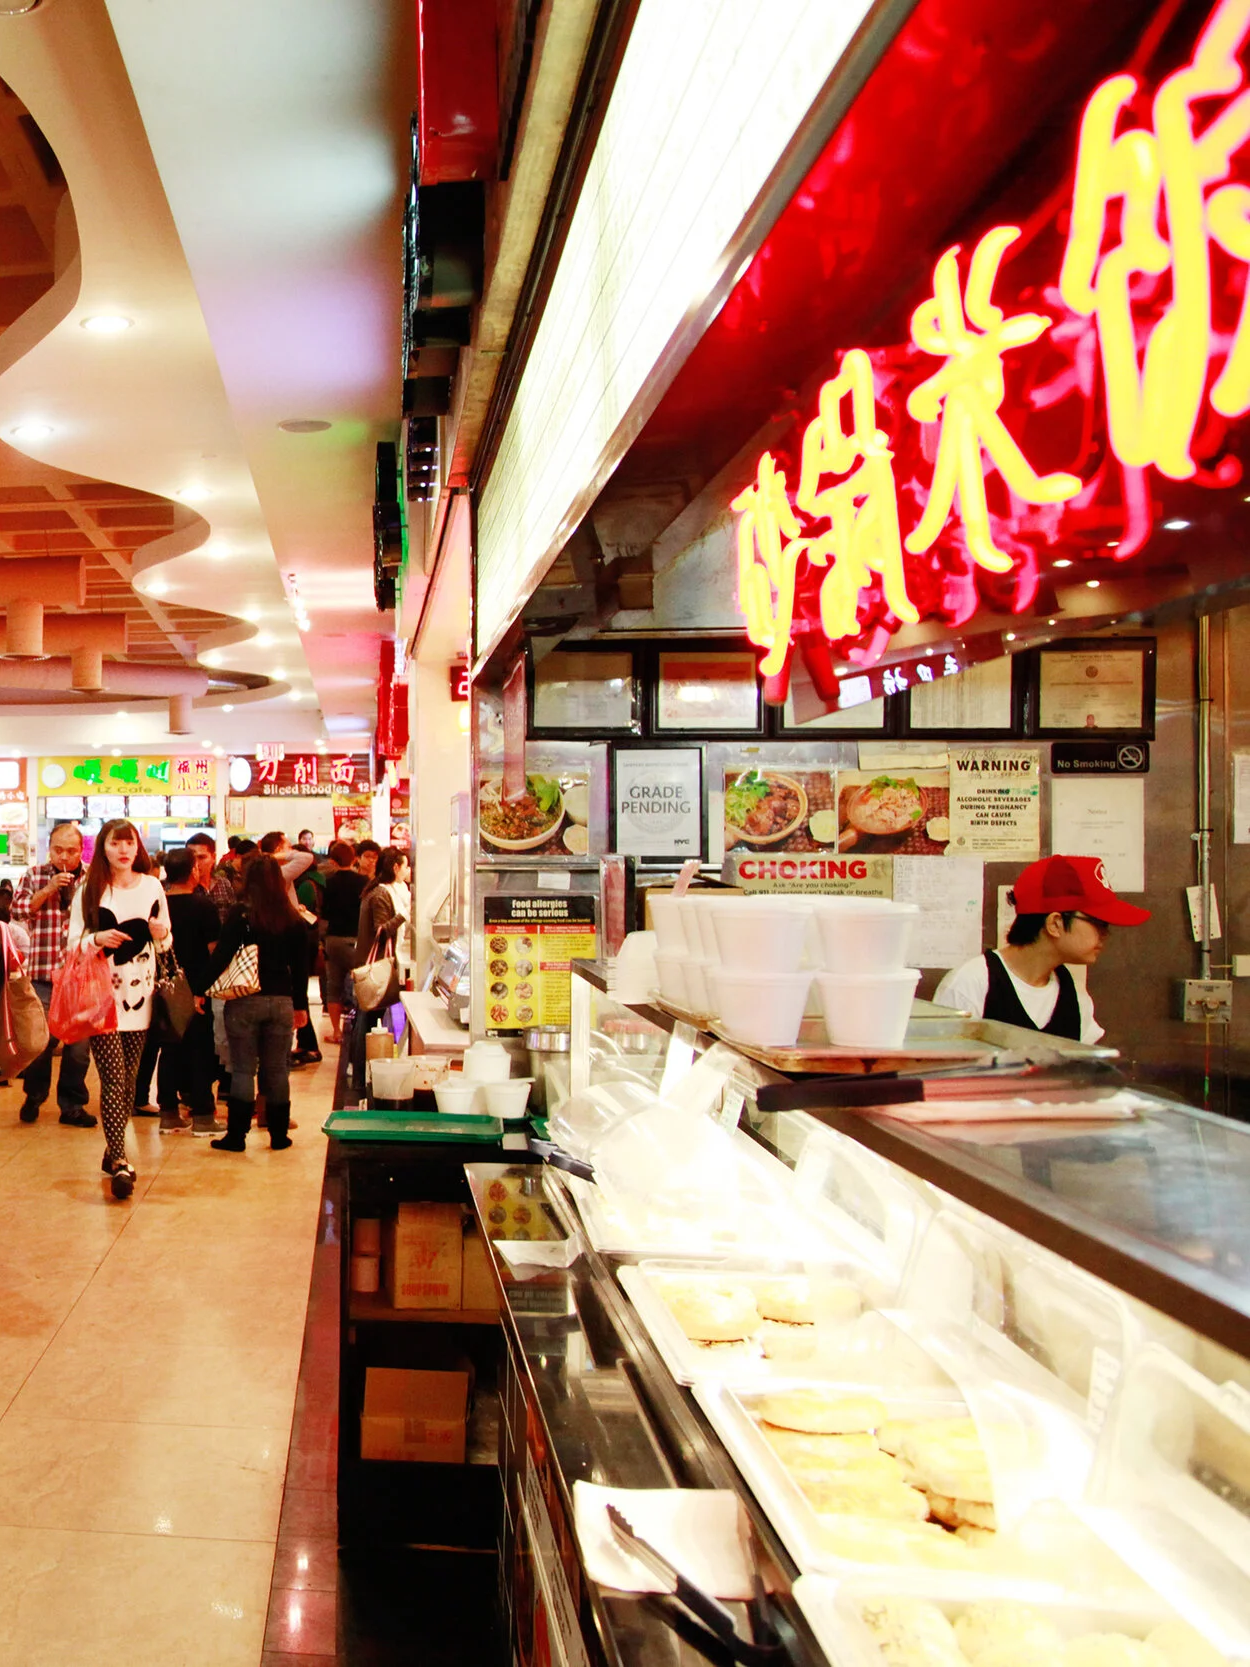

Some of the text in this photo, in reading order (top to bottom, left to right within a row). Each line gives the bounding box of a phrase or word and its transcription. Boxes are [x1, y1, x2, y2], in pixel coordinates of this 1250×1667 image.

[177, 760, 208, 774] 福州
[258, 756, 357, 784] 刀削面
[956, 760, 1031, 771] WARNING
[1057, 760, 1116, 769] No Smoking
[117, 786, 152, 794] Cafe
[177, 778, 209, 791] 小吃
[263, 783, 350, 795] Sliced Noodles
[629, 786, 683, 798] GRADE
[621, 801, 691, 814] PENDING
[738, 860, 867, 879] CHOKING
[512, 900, 568, 910] Food allergies
[511, 909, 569, 917] can be serious
